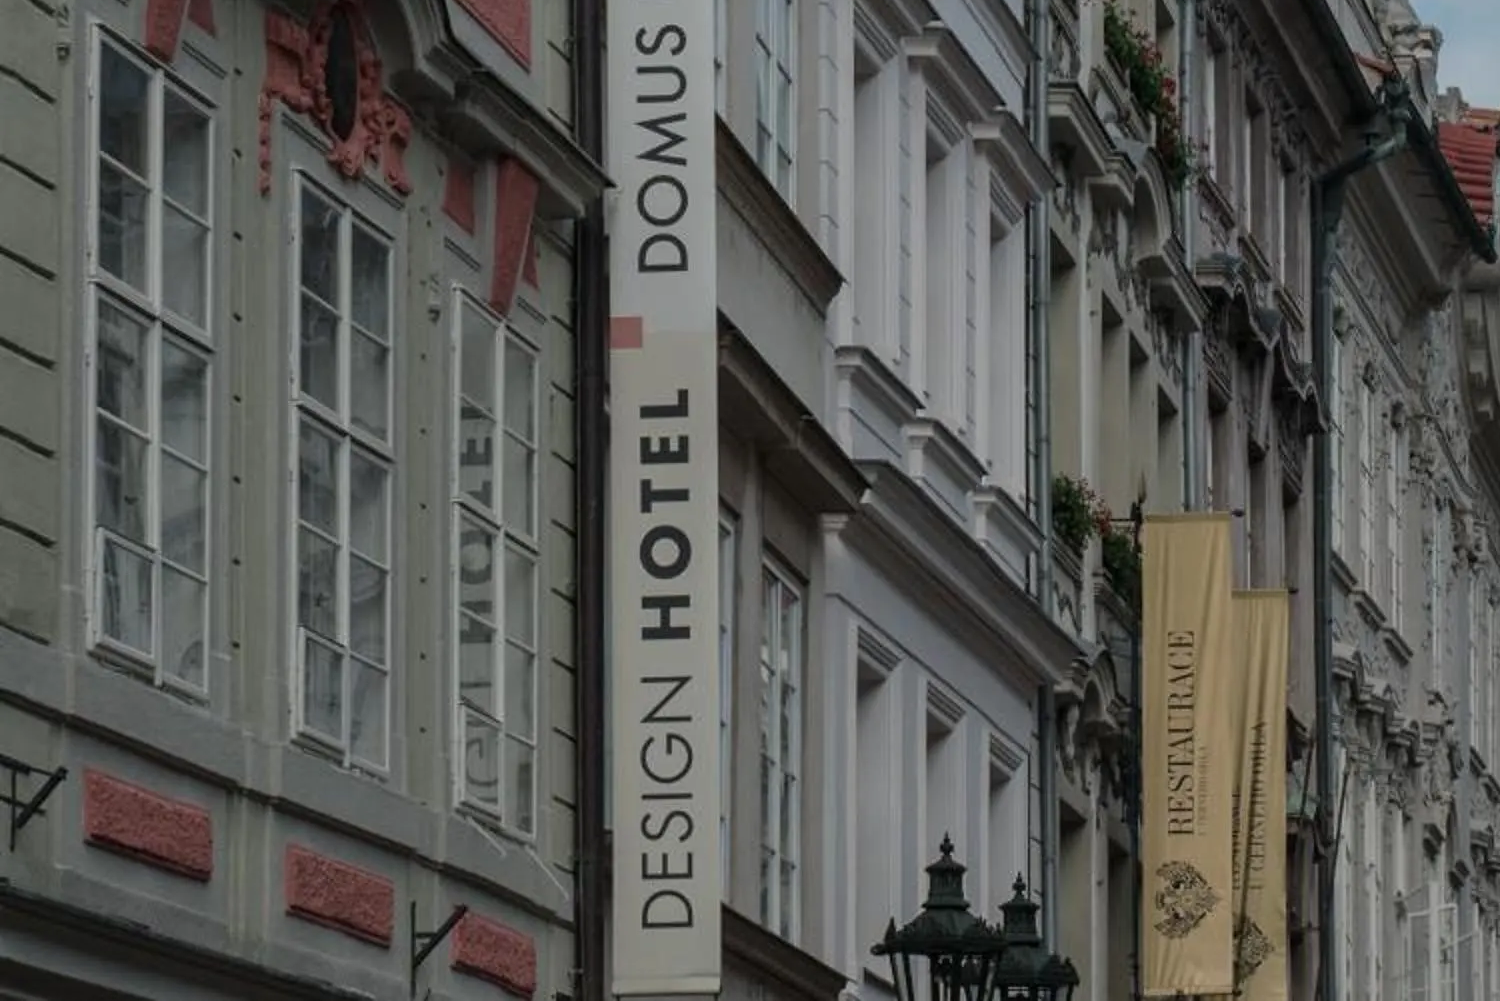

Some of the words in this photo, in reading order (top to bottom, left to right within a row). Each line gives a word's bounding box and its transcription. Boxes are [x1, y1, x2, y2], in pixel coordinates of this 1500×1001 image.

[636, 24, 688, 272] DOMUS
[640, 389, 691, 639] HOTEL
[641, 677, 693, 928] DESIGN
[1167, 630, 1195, 837] RESTAURACE
